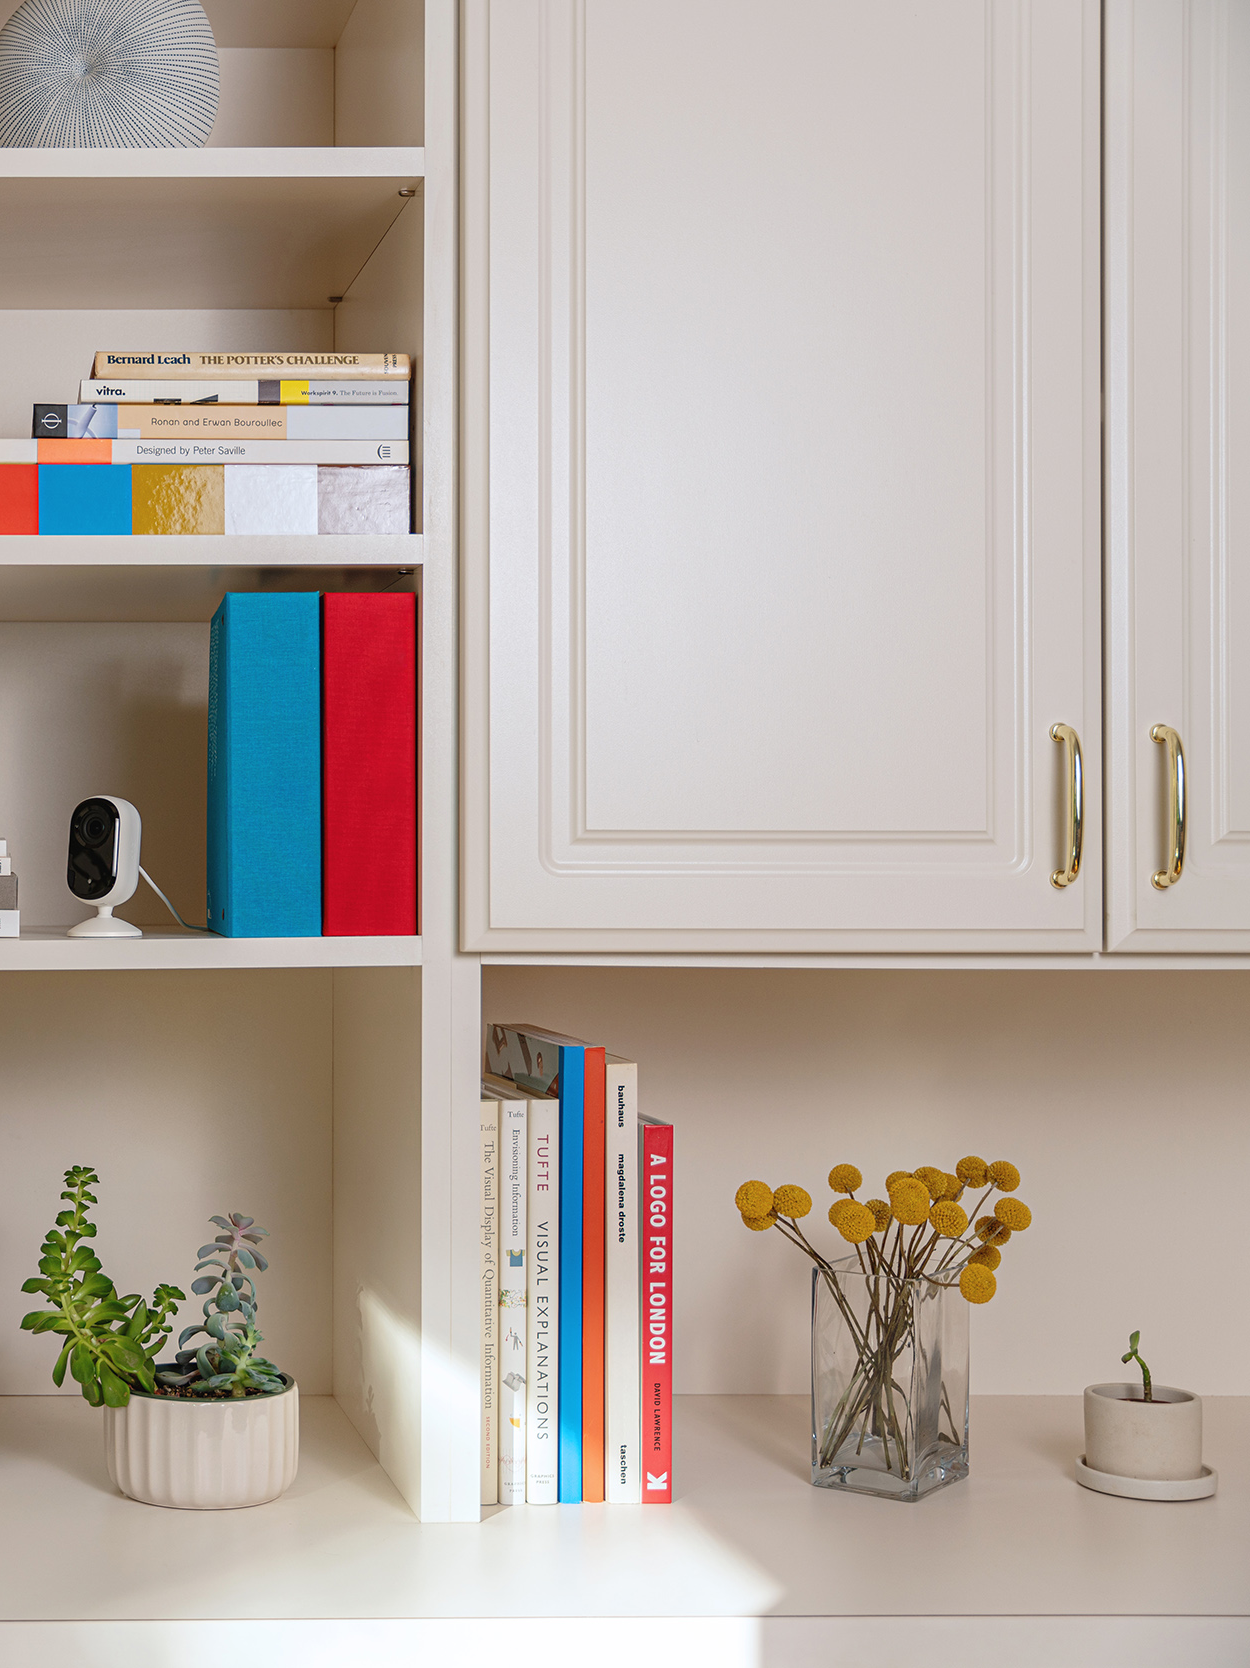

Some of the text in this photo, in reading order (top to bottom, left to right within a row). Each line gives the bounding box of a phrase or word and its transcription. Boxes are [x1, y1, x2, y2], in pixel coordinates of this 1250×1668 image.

[107, 354, 191, 365] Bernard Leach
[199, 355, 359, 365] THE POTTER'S CHALLENGE
[95, 386, 126, 396] vitra.
[151, 417, 283, 428] Ronan and Erwan Bouroullec
[136, 445, 246, 457] Designed by Peter Saville
[509, 1129, 520, 1236] Envisioning Information
[617, 1154, 625, 1208] magdalena
[649, 1154, 666, 1364] A LOGO FOR LONDON
[481, 1141, 496, 1409] The Visual Display of Quantitative Information
[537, 1135, 549, 1440] TUFTE VISUAL EXPLANATIONS
[647, 1471, 667, 1490] K
